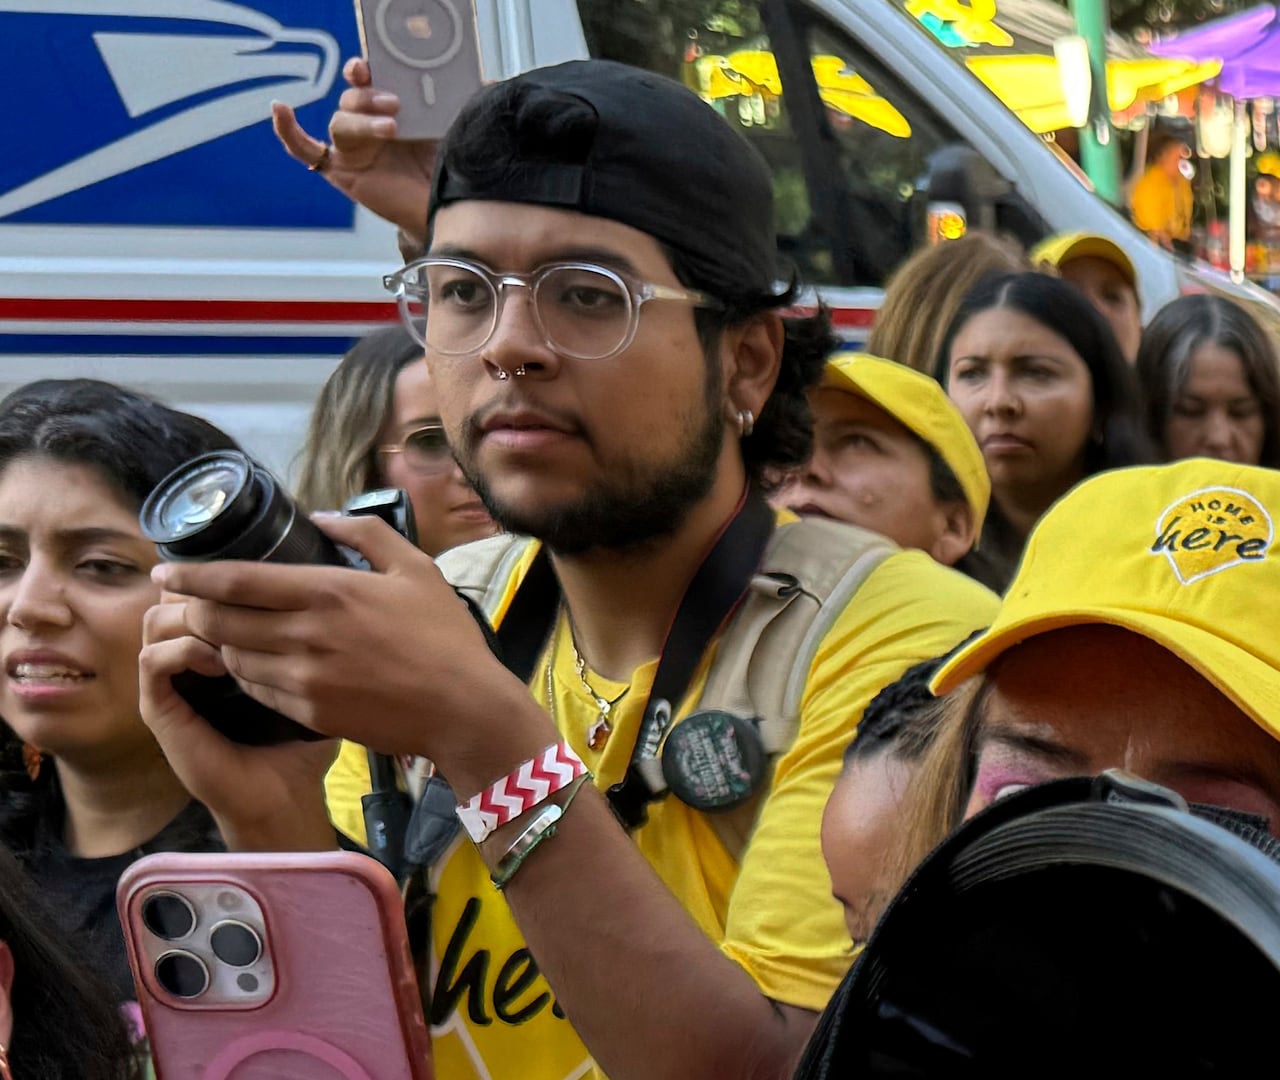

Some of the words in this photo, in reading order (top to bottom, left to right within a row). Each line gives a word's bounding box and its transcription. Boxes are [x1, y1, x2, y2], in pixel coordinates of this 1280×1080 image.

[1190, 499, 1255, 525] HOME
[1151, 516, 1267, 560] here
[430, 897, 566, 1026] he
